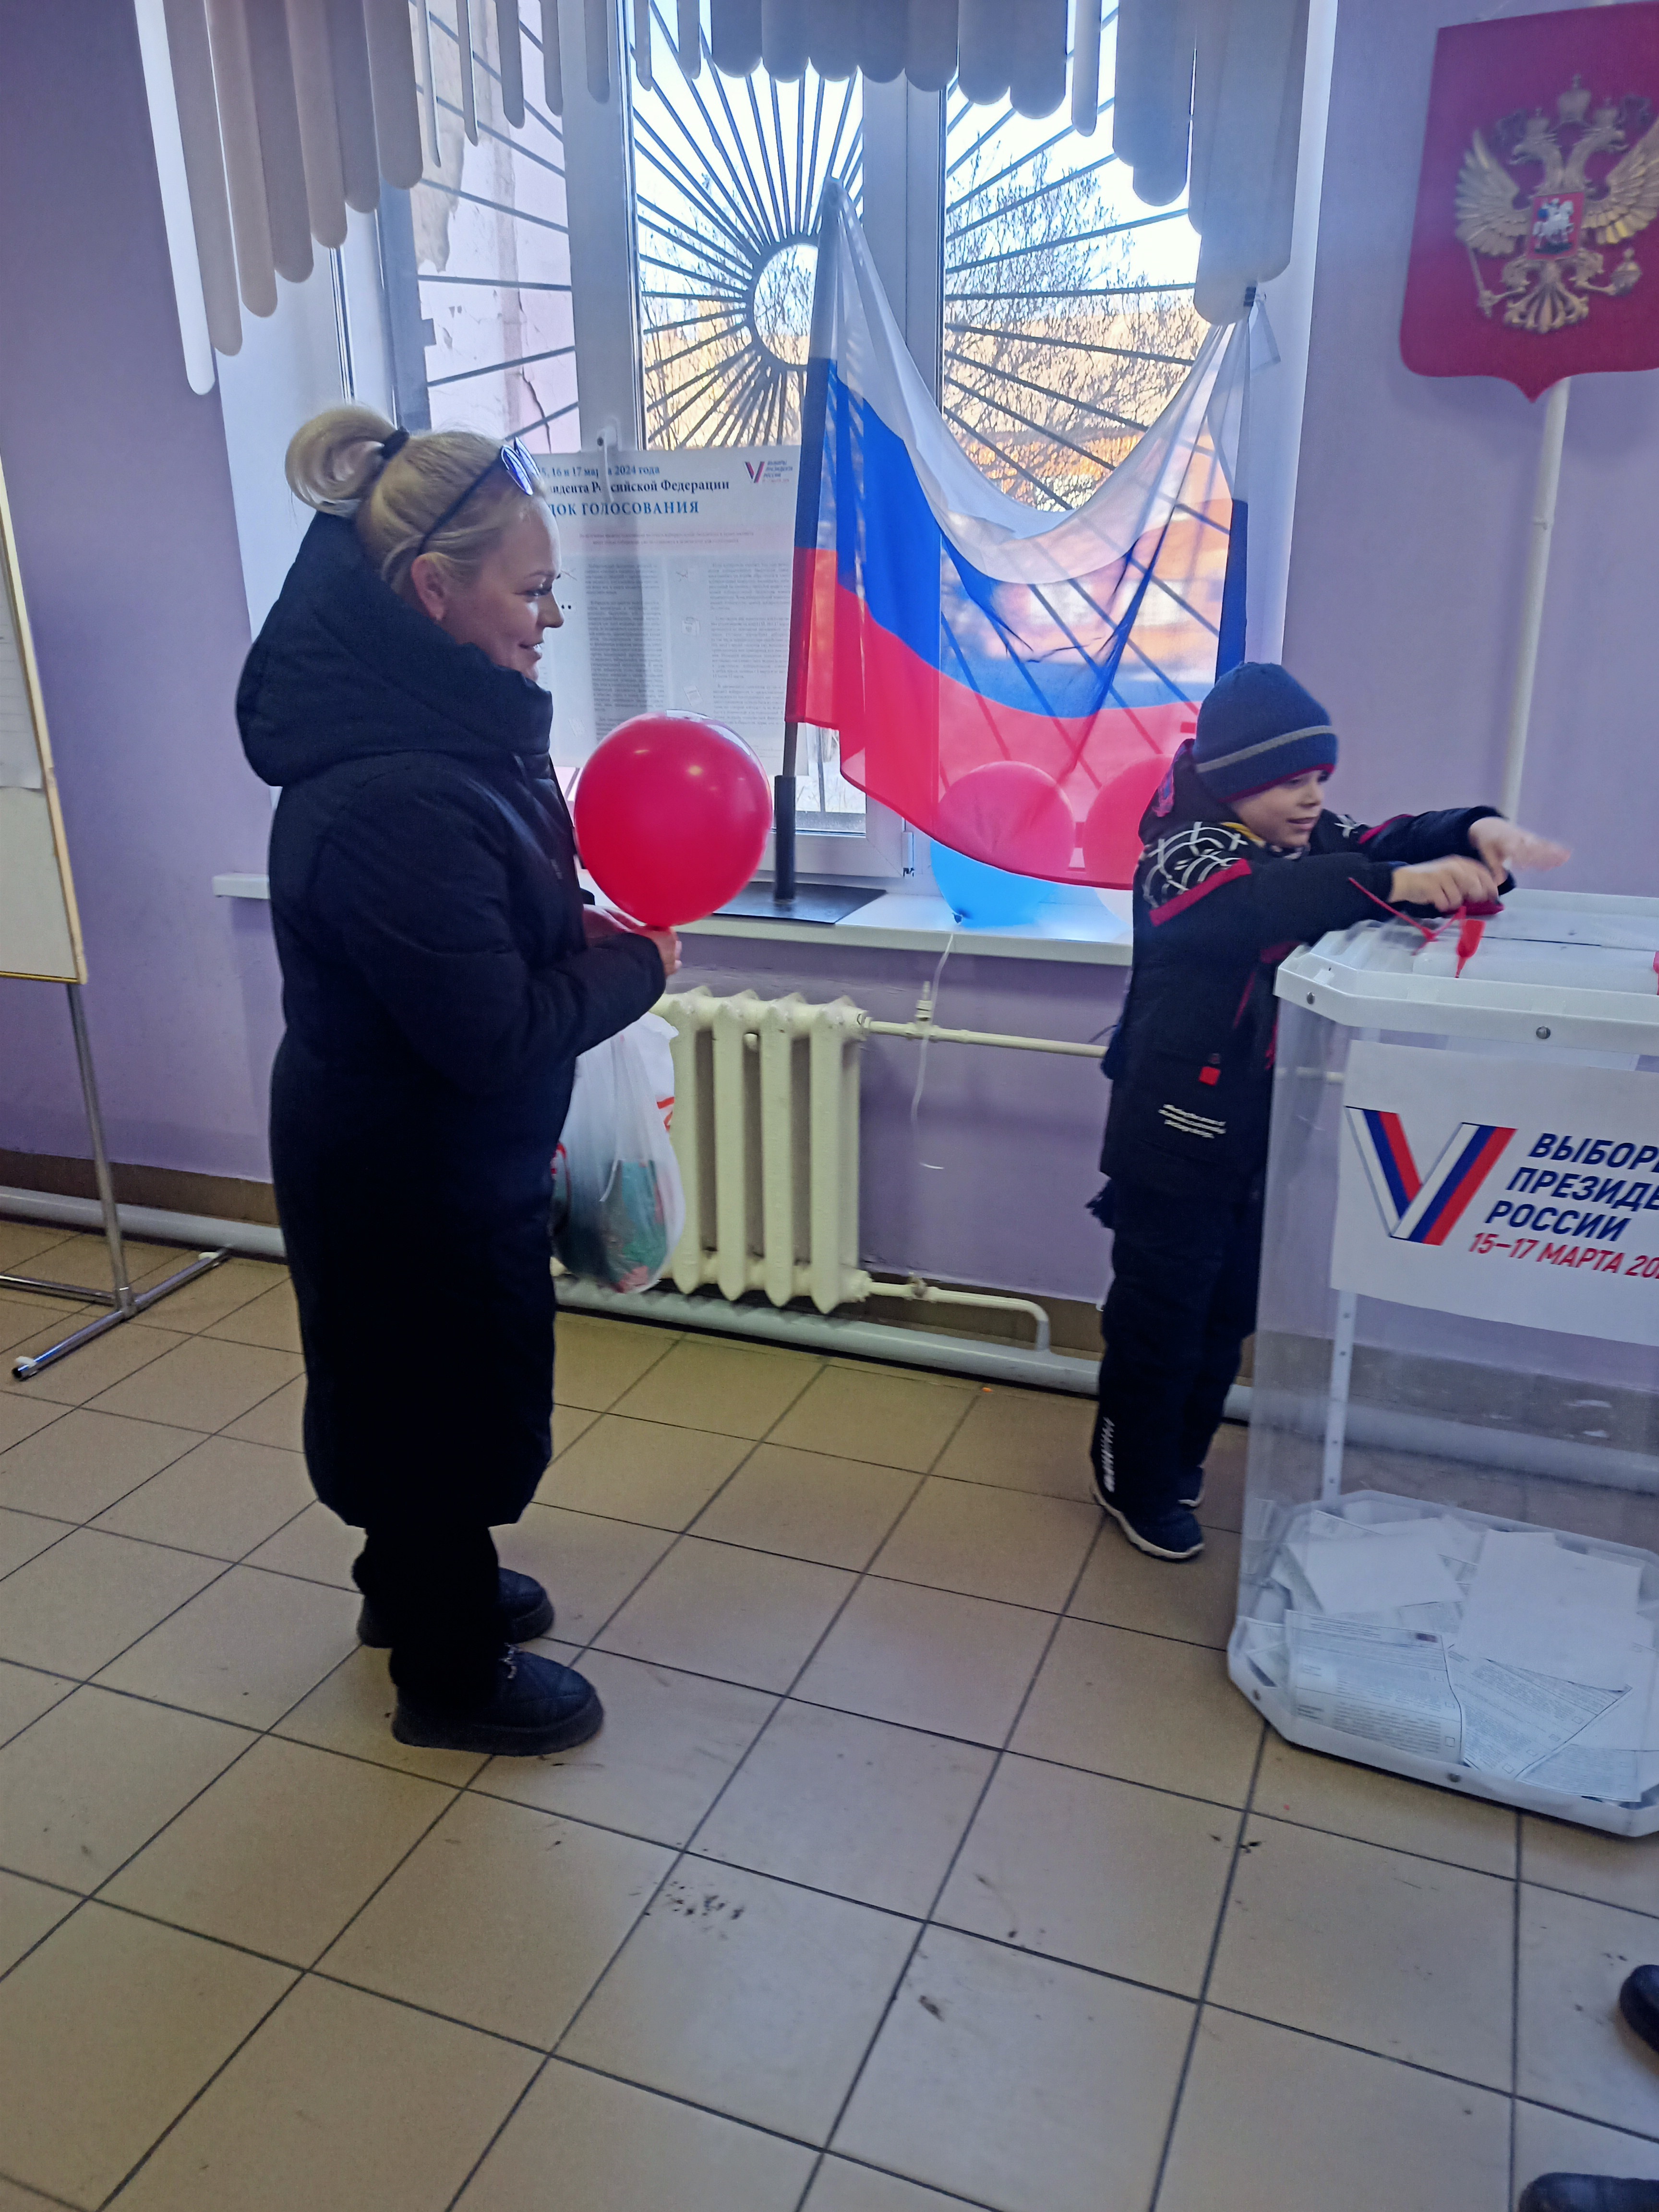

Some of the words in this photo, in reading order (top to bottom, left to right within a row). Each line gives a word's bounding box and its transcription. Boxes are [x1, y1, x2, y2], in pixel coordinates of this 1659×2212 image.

[553, 467, 562, 477] 16
[573, 467, 582, 477] 17
[615, 465, 636, 476] 2024
[638, 466, 660, 475] года
[661, 479, 729, 494] Федерации
[582, 501, 699, 516] ГОЛОСОВАНИЯ
[1527, 1132, 1659, 1174] ВЫБОР
[1485, 1200, 1632, 1242] РОССИИ
[1535, 1242, 1625, 1274] МАРТА
[1623, 1254, 1659, 1280] 20
